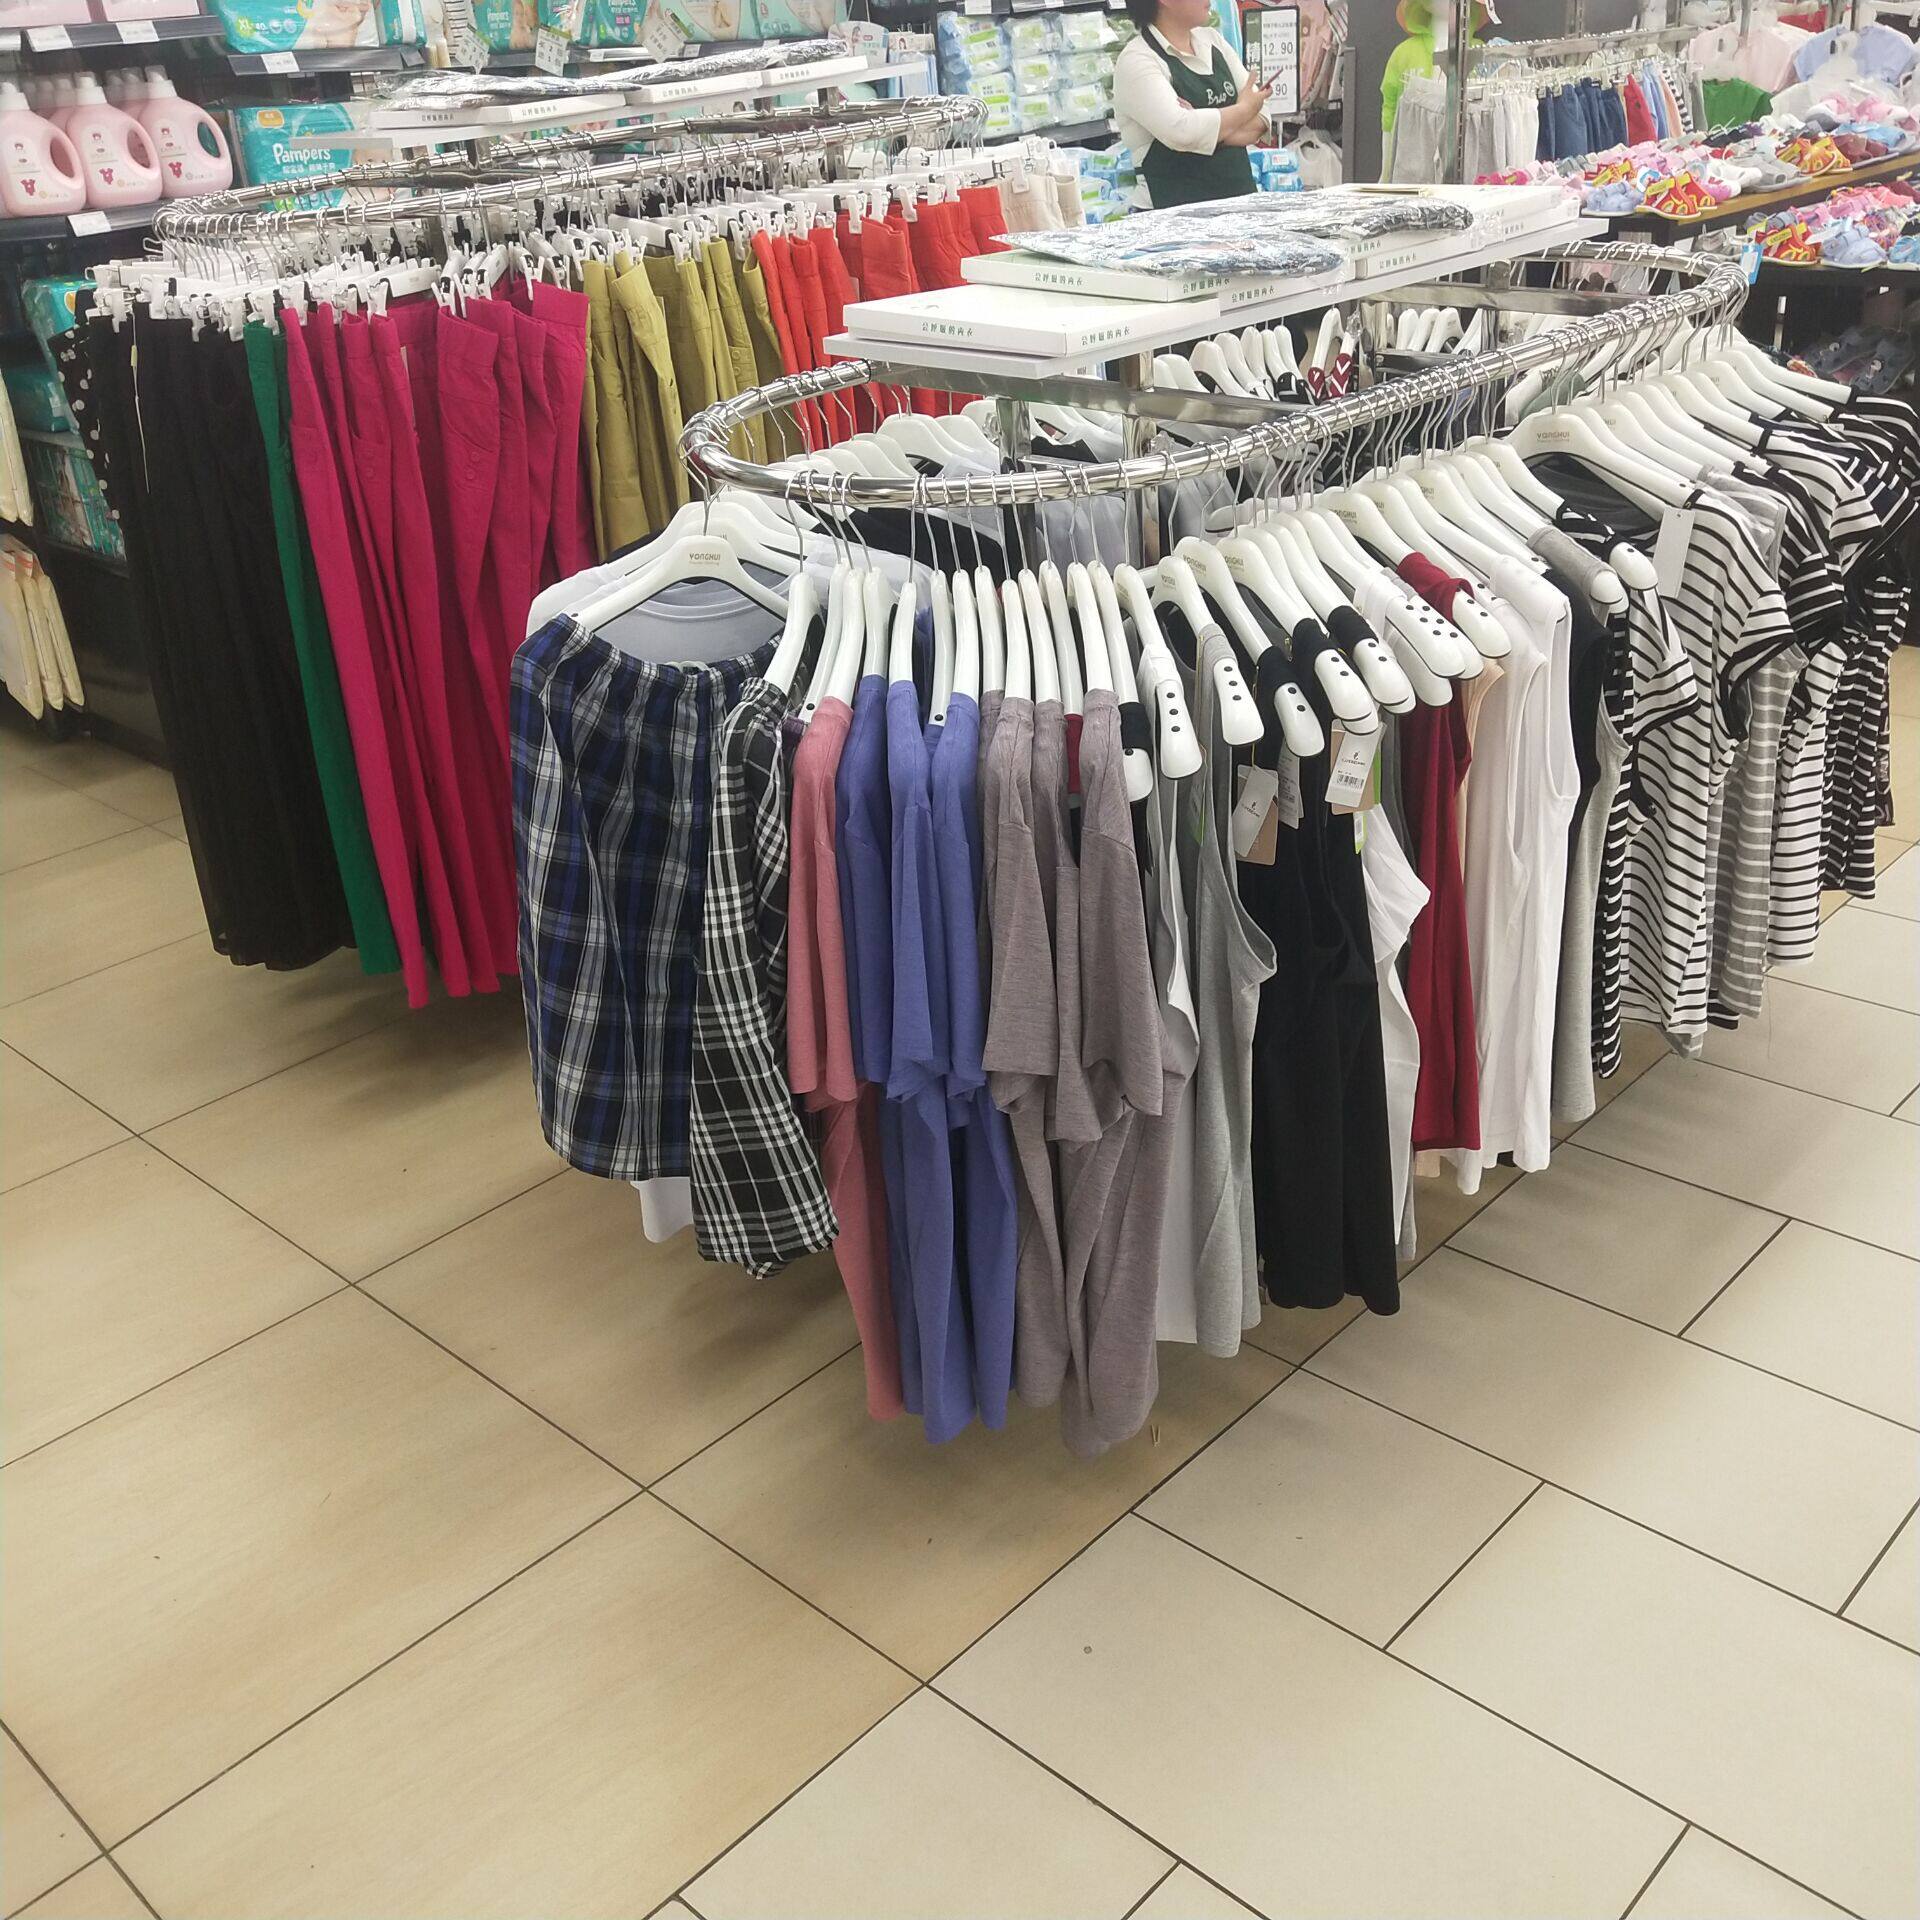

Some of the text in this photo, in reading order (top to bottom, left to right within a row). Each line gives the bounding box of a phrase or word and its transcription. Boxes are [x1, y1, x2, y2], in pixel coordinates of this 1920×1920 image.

[1263, 42, 1293, 55] 12.90
[272, 143, 331, 165] Pampers
[1536, 431, 1569, 439] YONGHUI
[689, 553, 721, 561] YONGHUI
